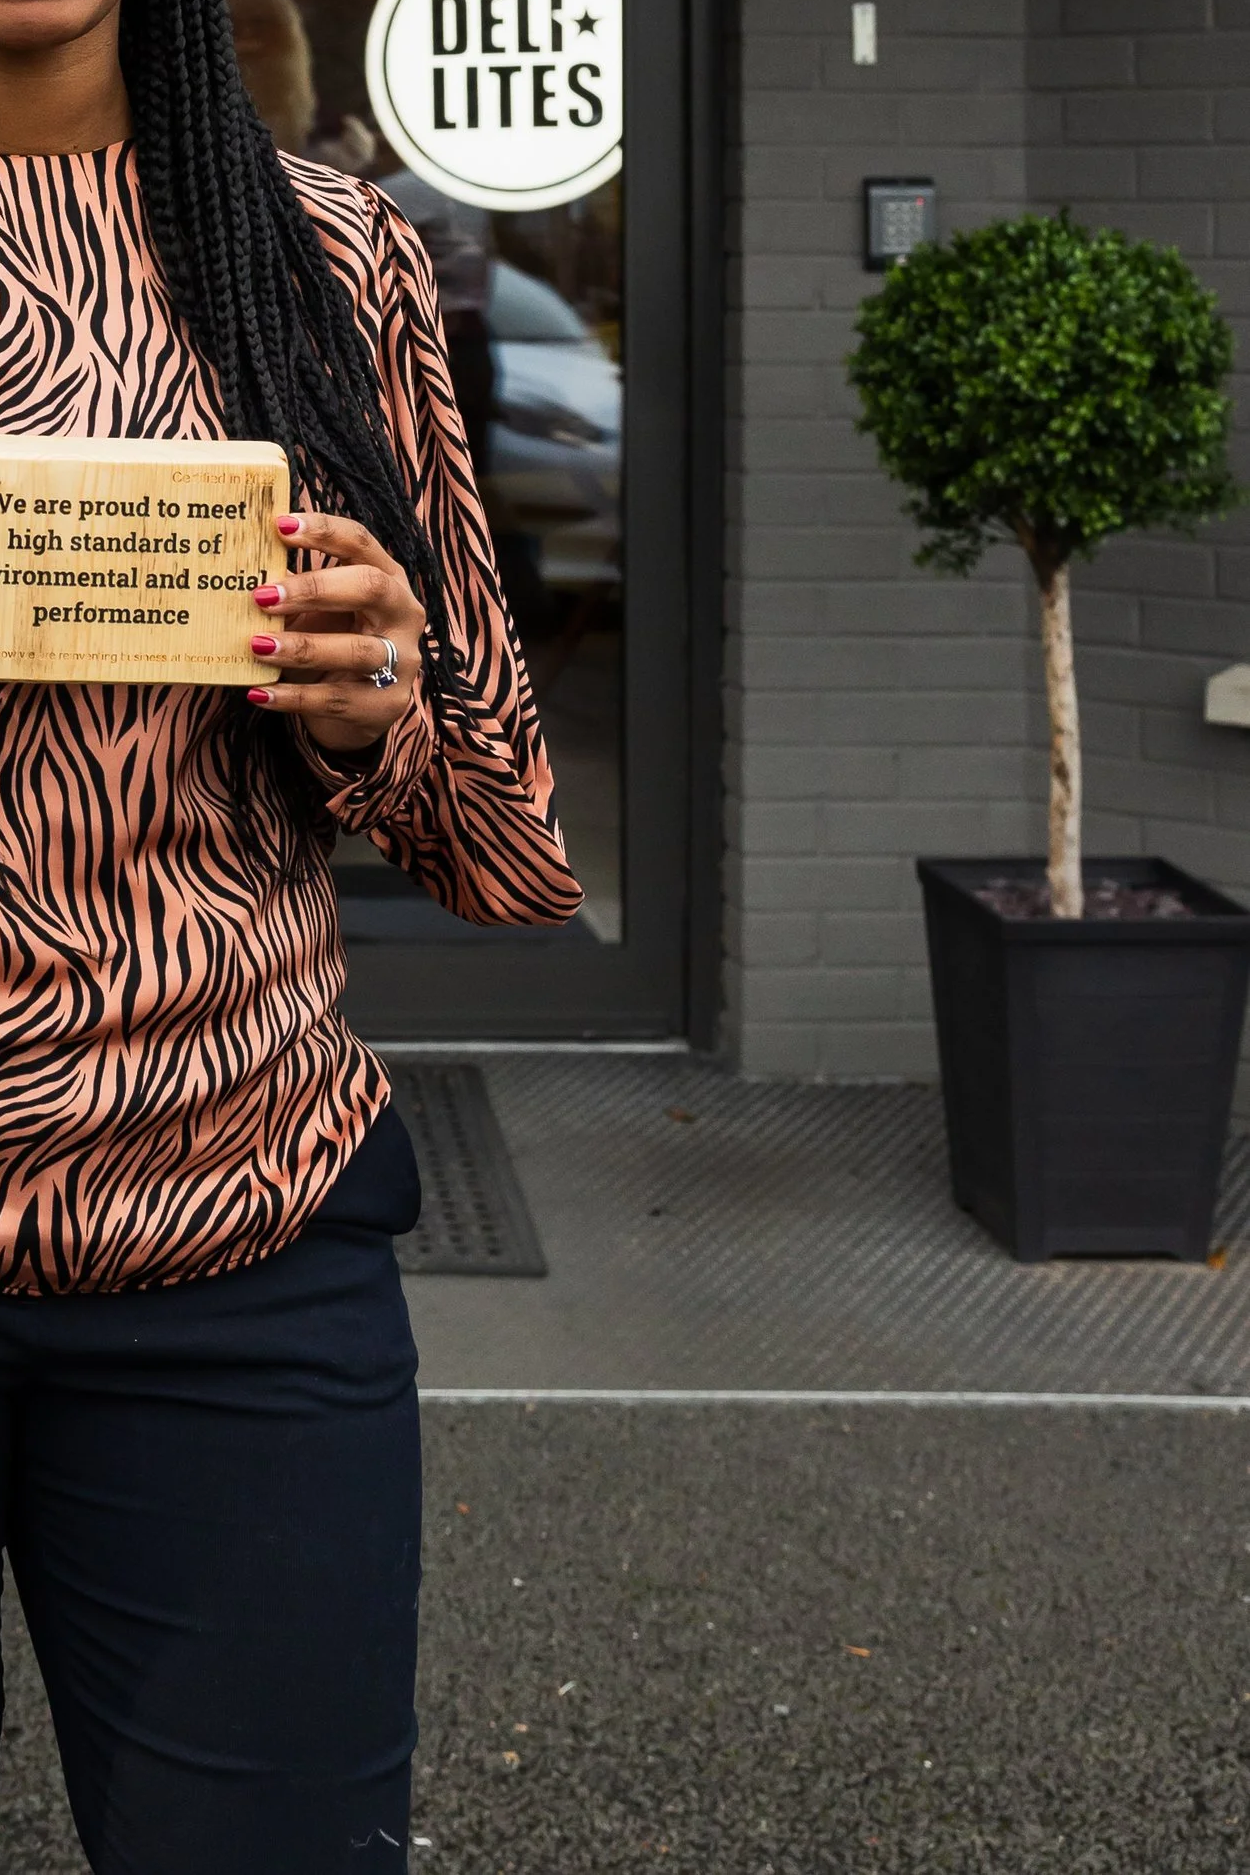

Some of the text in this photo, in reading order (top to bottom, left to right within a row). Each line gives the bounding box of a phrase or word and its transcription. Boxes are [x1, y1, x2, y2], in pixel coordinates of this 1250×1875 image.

[432, 62, 603, 130] LITES
[33, 497, 73, 515] are
[78, 496, 151, 521] proud
[156, 498, 181, 518] to
[187, 501, 247, 520] meet
[7, 528, 222, 556] high standards of
[145, 568, 191, 590] and
[197, 569, 268, 592] social
[32, 601, 190, 627] performance
